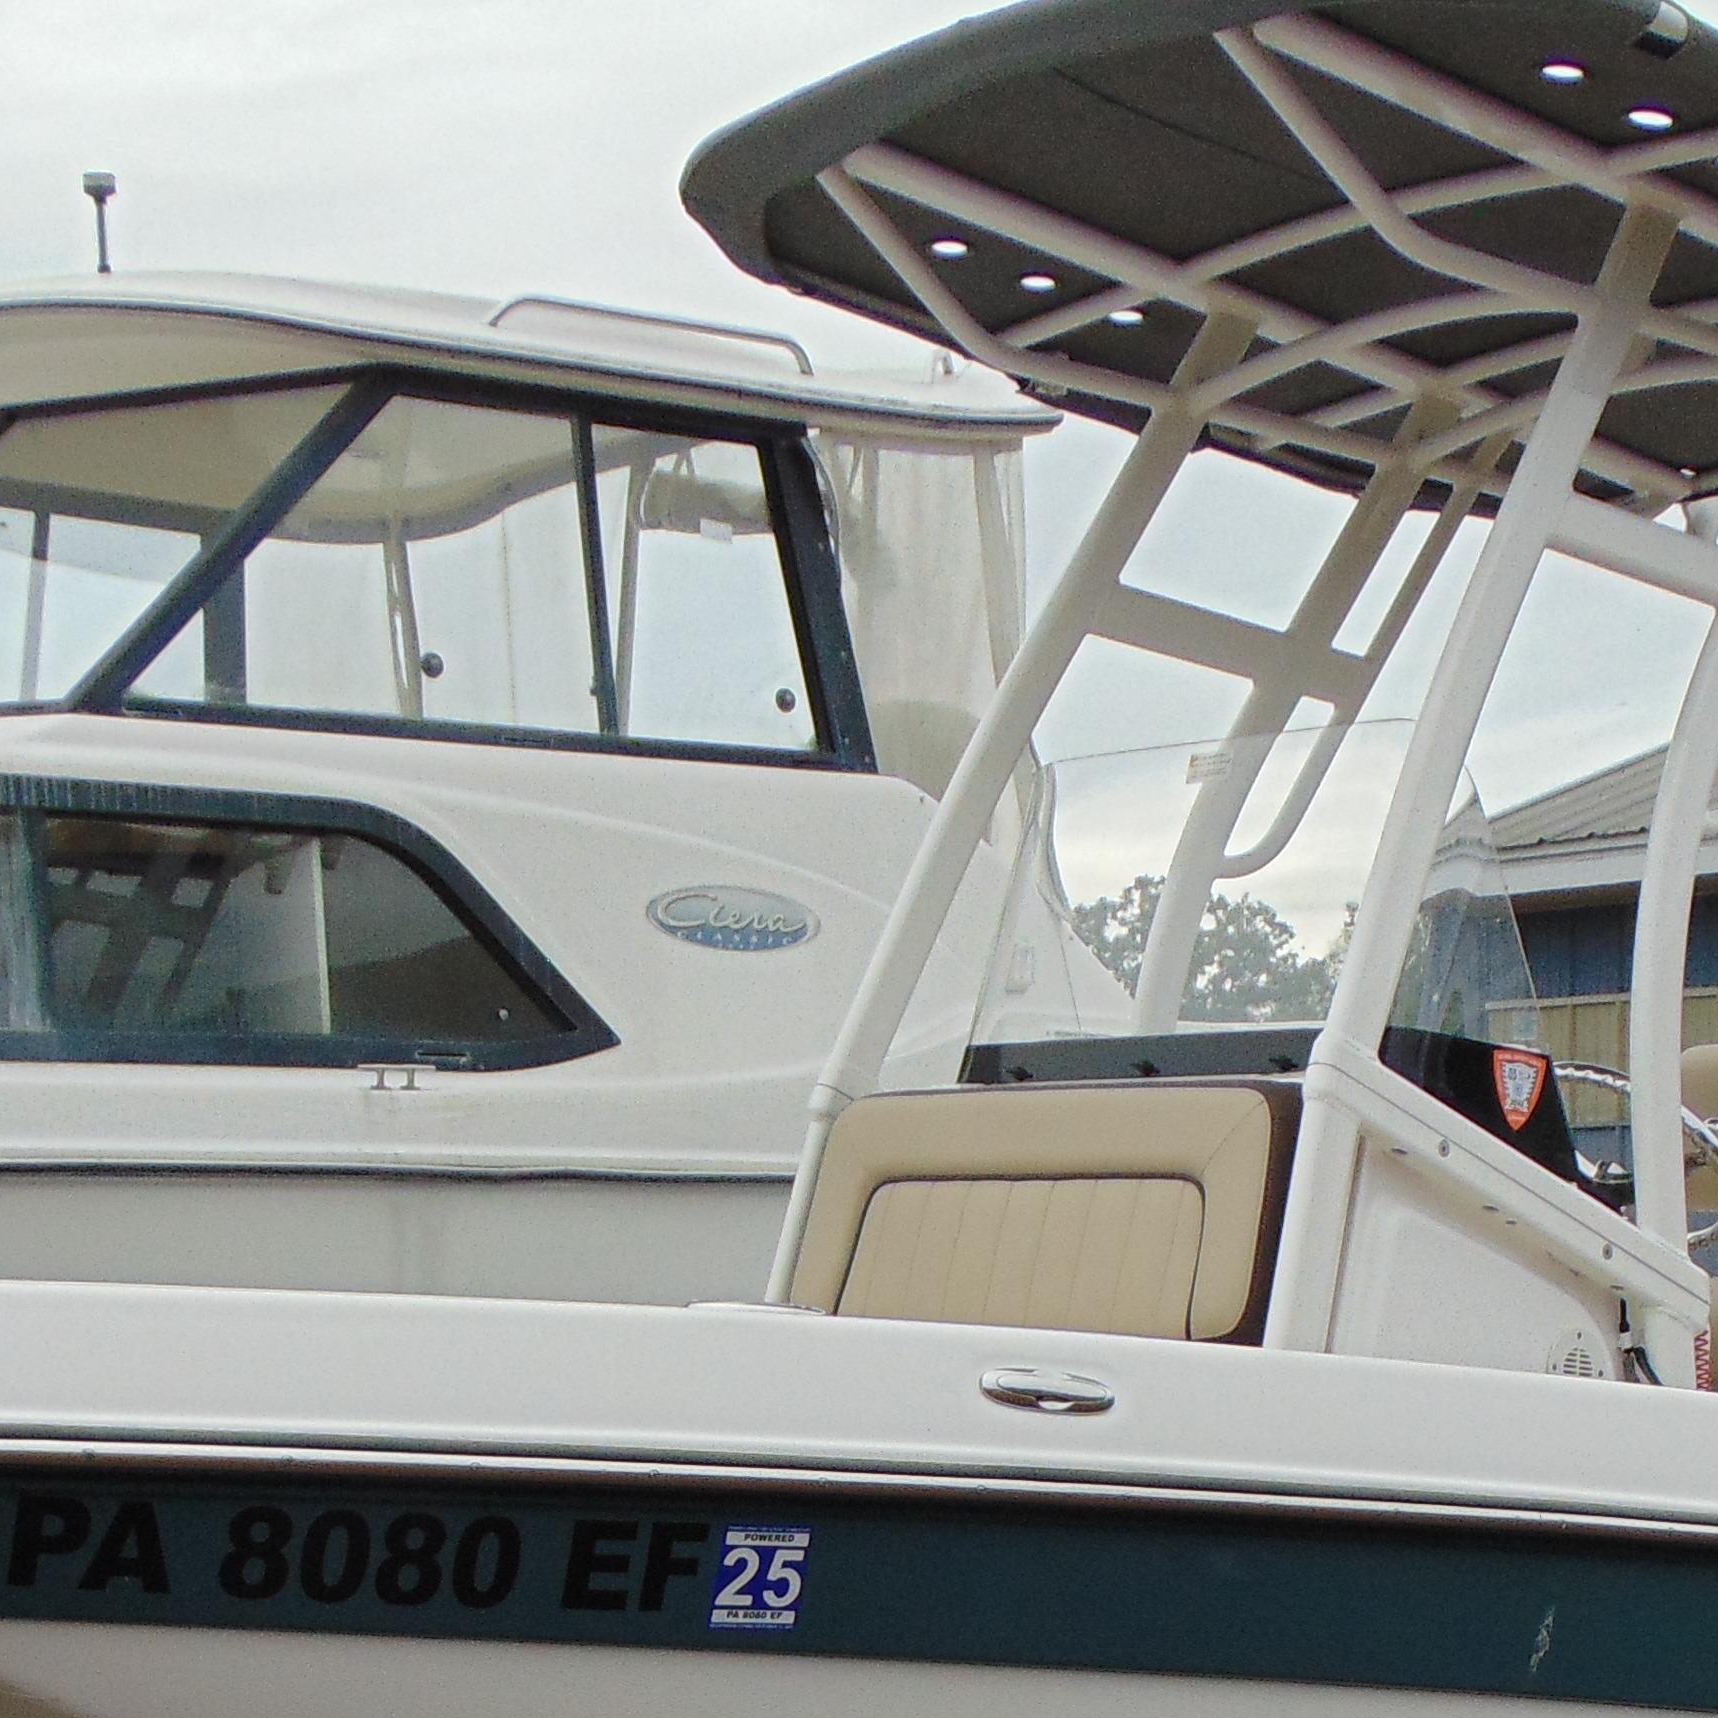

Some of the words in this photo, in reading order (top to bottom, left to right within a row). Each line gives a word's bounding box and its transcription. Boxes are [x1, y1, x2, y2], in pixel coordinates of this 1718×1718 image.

[657, 892, 807, 932] Ciera
[7, 1492, 173, 1596] PA
[218, 1504, 522, 1609] 8080
[560, 1518, 711, 1613] EF
[744, 1532, 795, 1543] POWERED
[714, 1547, 805, 1608] 25
